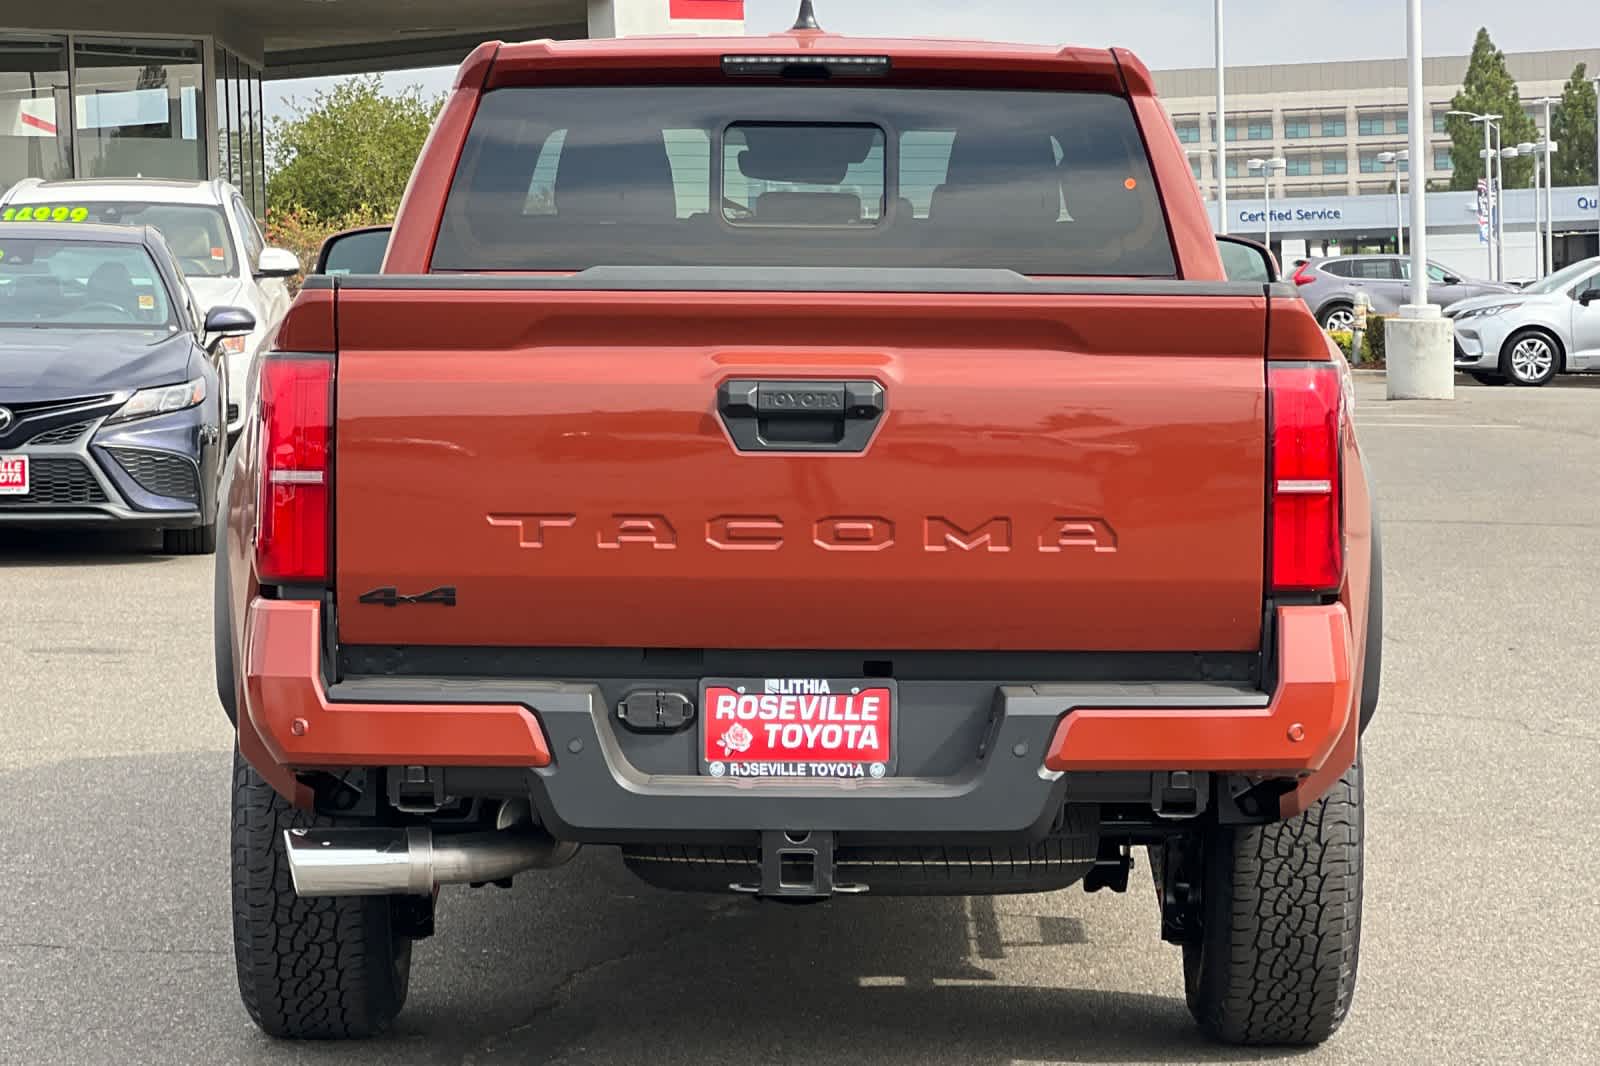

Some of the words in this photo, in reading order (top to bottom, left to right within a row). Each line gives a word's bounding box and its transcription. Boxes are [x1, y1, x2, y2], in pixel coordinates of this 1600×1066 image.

[1240, 209, 1292, 222] Certfied
[1296, 208, 1341, 221] Service
[762, 391, 841, 408] TOYOTA
[486, 512, 1119, 554] TACOMA
[780, 679, 830, 694] LITHIA
[715, 695, 880, 721] ROSEVILLE
[764, 723, 880, 749] TOYOTA
[730, 763, 806, 776] ROSEVILLE
[809, 764, 864, 777] TOYOTA
